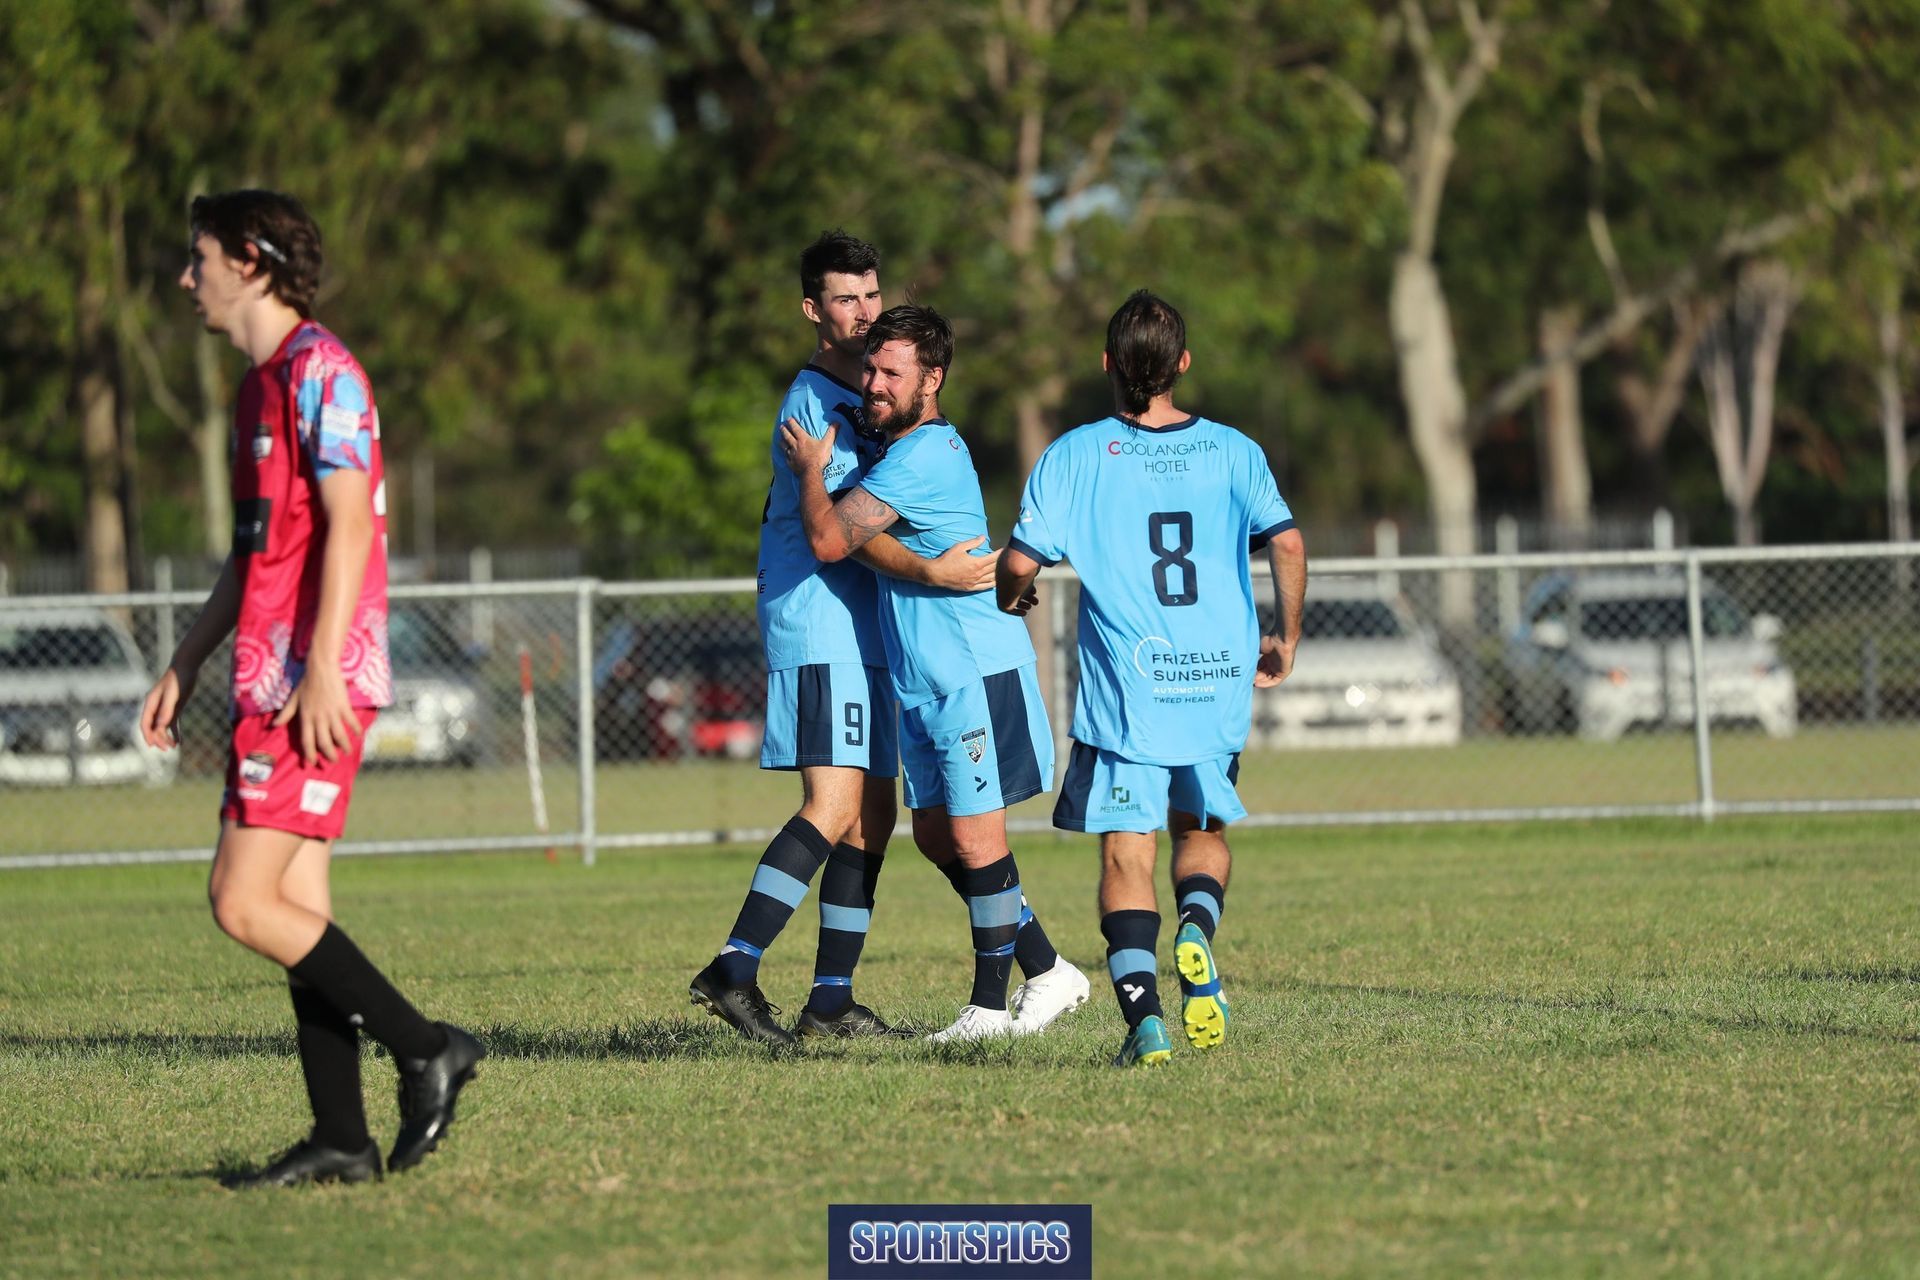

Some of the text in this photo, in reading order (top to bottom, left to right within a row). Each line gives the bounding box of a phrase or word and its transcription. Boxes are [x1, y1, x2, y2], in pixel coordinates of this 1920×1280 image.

[1108, 440, 1219, 457] COOLANGATTA
[1144, 459, 1191, 474] HOTEL
[1148, 511, 1199, 607] 8
[1152, 650, 1231, 665] FRIZELLE
[1153, 666, 1241, 682] SUNSHINE
[1153, 685, 1216, 695] AUTOMOTIVE
[1153, 695, 1216, 704] TWEED HEADS
[844, 702, 864, 747] 9
[1100, 803, 1142, 813] METALABS
